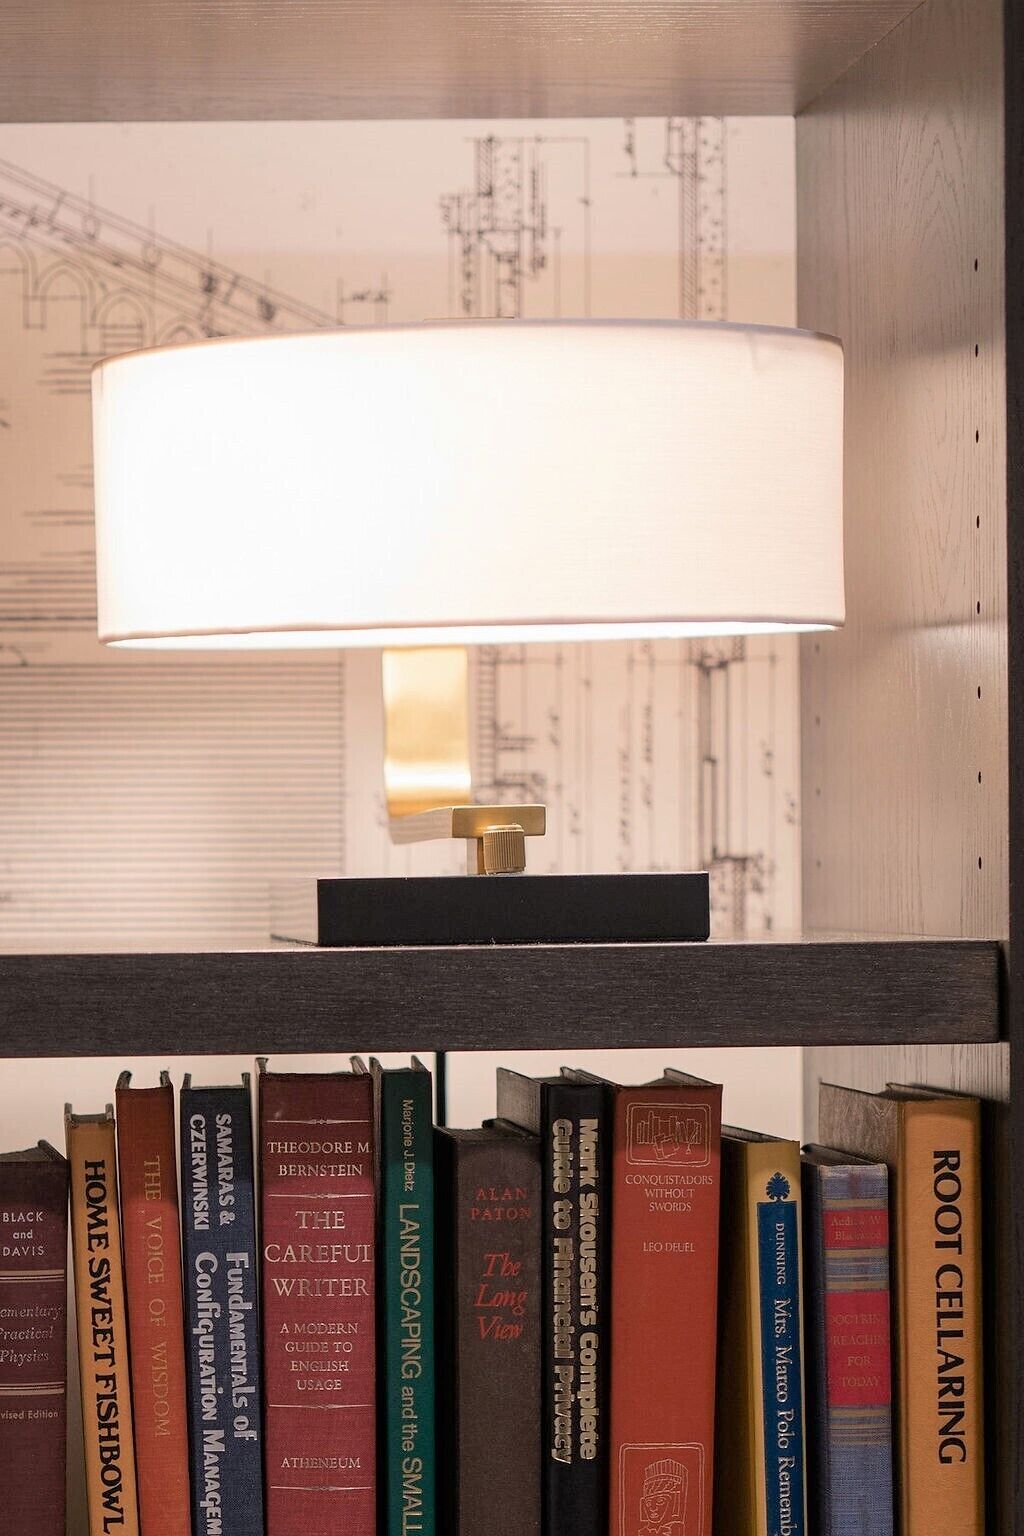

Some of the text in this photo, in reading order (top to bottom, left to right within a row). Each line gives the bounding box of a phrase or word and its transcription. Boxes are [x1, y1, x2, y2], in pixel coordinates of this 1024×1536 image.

[279, 1164, 362, 1177] BERNSTEIN
[2, 1211, 43, 1223] BLACK
[84, 1159, 107, 1252] HOME
[296, 1210, 346, 1231] THE
[13, 1230, 33, 1240] and
[2, 1246, 44, 1257] DAVIS
[273, 1276, 370, 1298] WRITER
[399, 1203, 421, 1380] LANDSCAPING
[88, 1259, 115, 1368] SWEET
[932, 1150, 967, 1466] ROOT CELLARING
[402, 1386, 418, 1418] and
[402, 1423, 417, 1451] the
[95, 1373, 125, 1534] FISHBOWL
[281, 1456, 361, 1469] ATHENEUM
